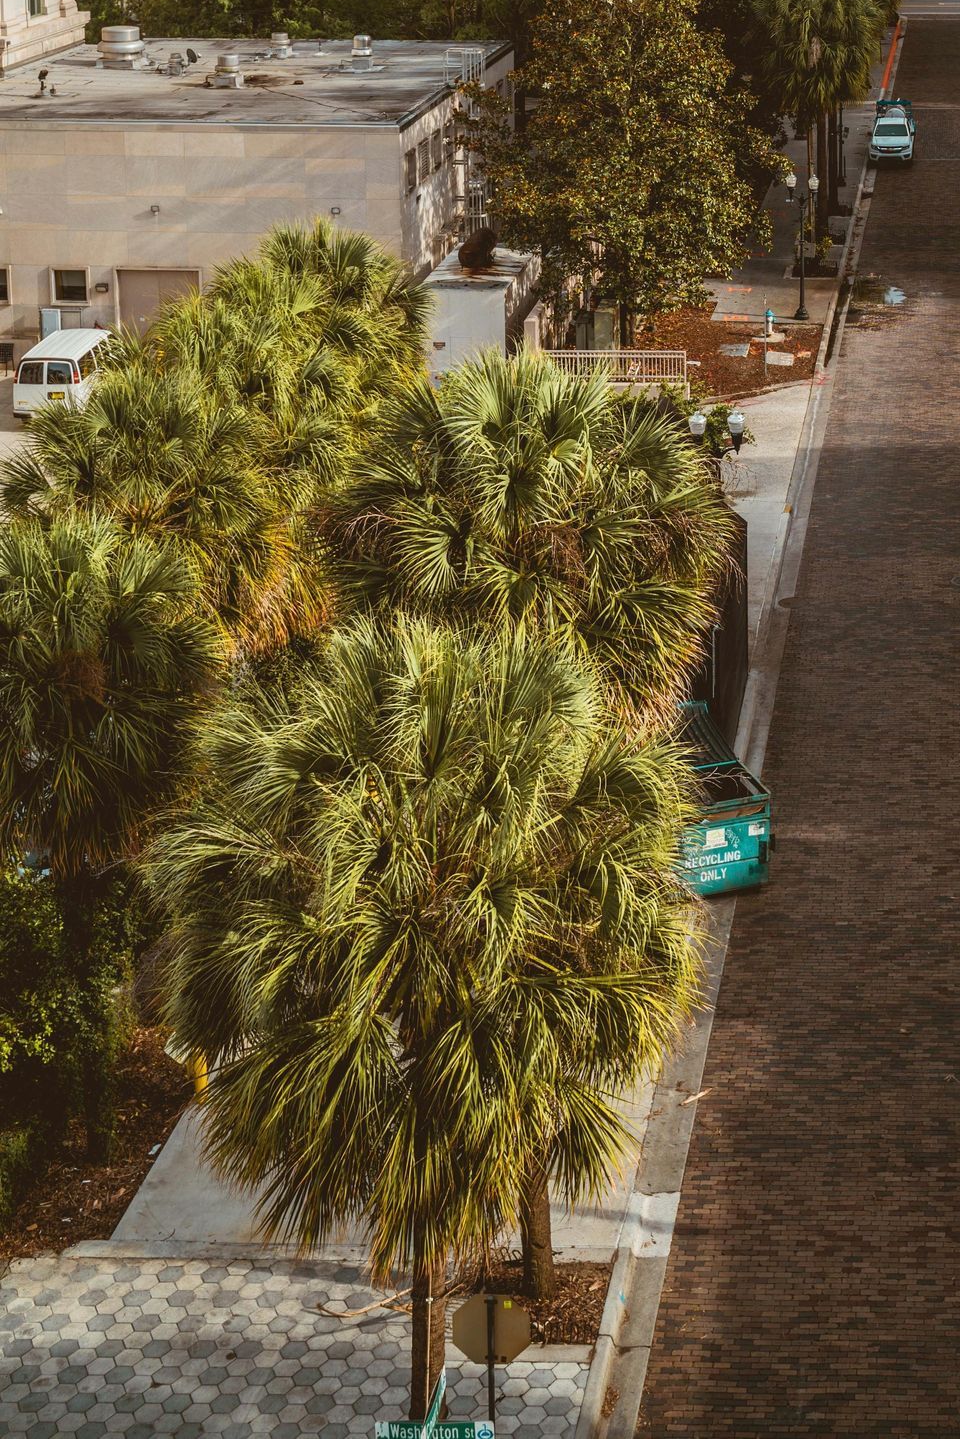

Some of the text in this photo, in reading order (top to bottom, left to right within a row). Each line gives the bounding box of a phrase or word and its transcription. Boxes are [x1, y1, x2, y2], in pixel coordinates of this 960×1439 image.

[684, 850, 741, 869] RECYCLING
[700, 867, 728, 882] ONLY
[390, 1424, 459, 1439] Washgton
